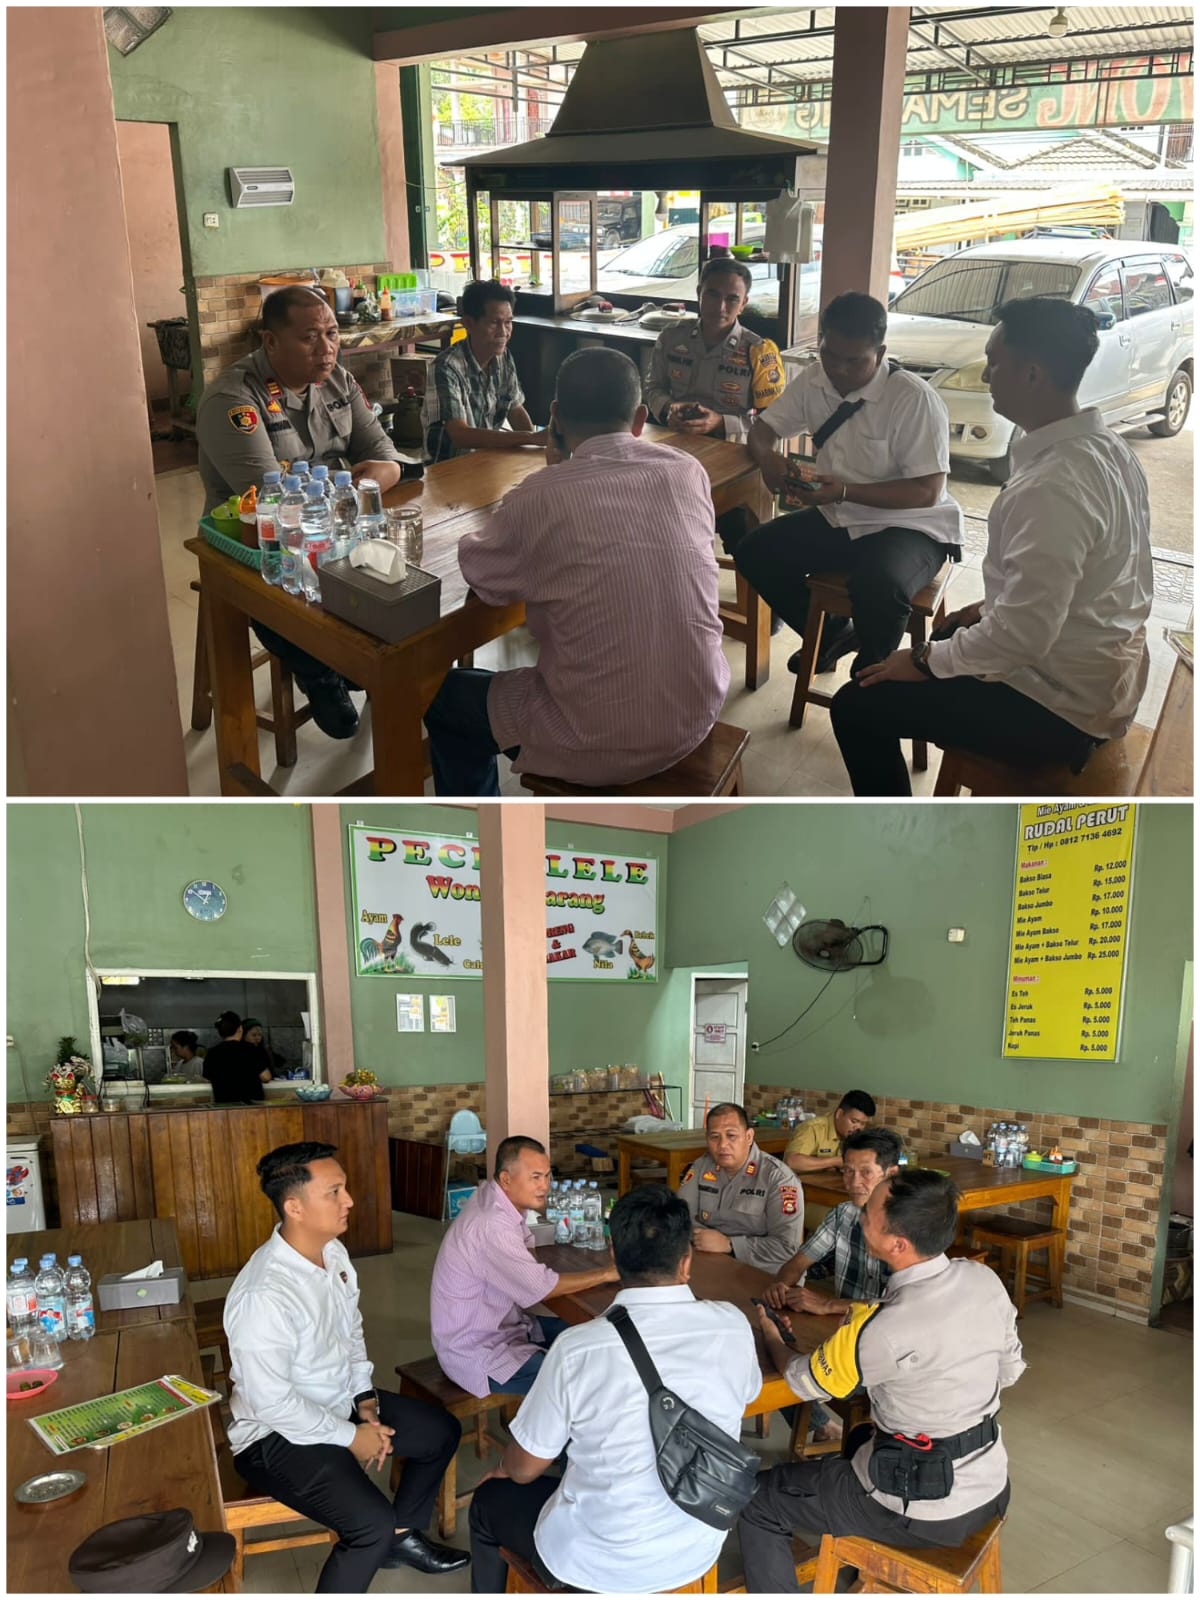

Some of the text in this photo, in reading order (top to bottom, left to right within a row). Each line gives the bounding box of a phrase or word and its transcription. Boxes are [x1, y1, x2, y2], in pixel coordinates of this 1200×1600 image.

[1024, 804, 1129, 840] RUDAL PERUT
[1060, 836, 1078, 846] 0812
[1080, 832, 1100, 842] 7136
[366, 836, 649, 885] PEC LELE
[1106, 860, 1127, 869] 12.000
[1105, 875, 1126, 885] 15.000
[426, 875, 606, 915] Won arang
[1103, 890, 1125, 900] 17.000
[1102, 905, 1123, 915] 10.000
[361, 909, 388, 925] Ayam
[1101, 920, 1122, 929] 17.000
[434, 934, 461, 947] Lele
[551, 939, 561, 950] &
[1100, 935, 1121, 944] 20.000
[546, 948, 576, 964] AKAR
[1098, 950, 1120, 959] 25.000
[593, 959, 614, 969] Nila
[1095, 987, 1113, 995] 5.000
[1094, 1001, 1111, 1009] 5.000
[1093, 1015, 1110, 1023] 5.000
[1092, 1030, 1109, 1038] 5.000
[1090, 1044, 1108, 1052] 5.000
[740, 1188, 765, 1198] POLRI
